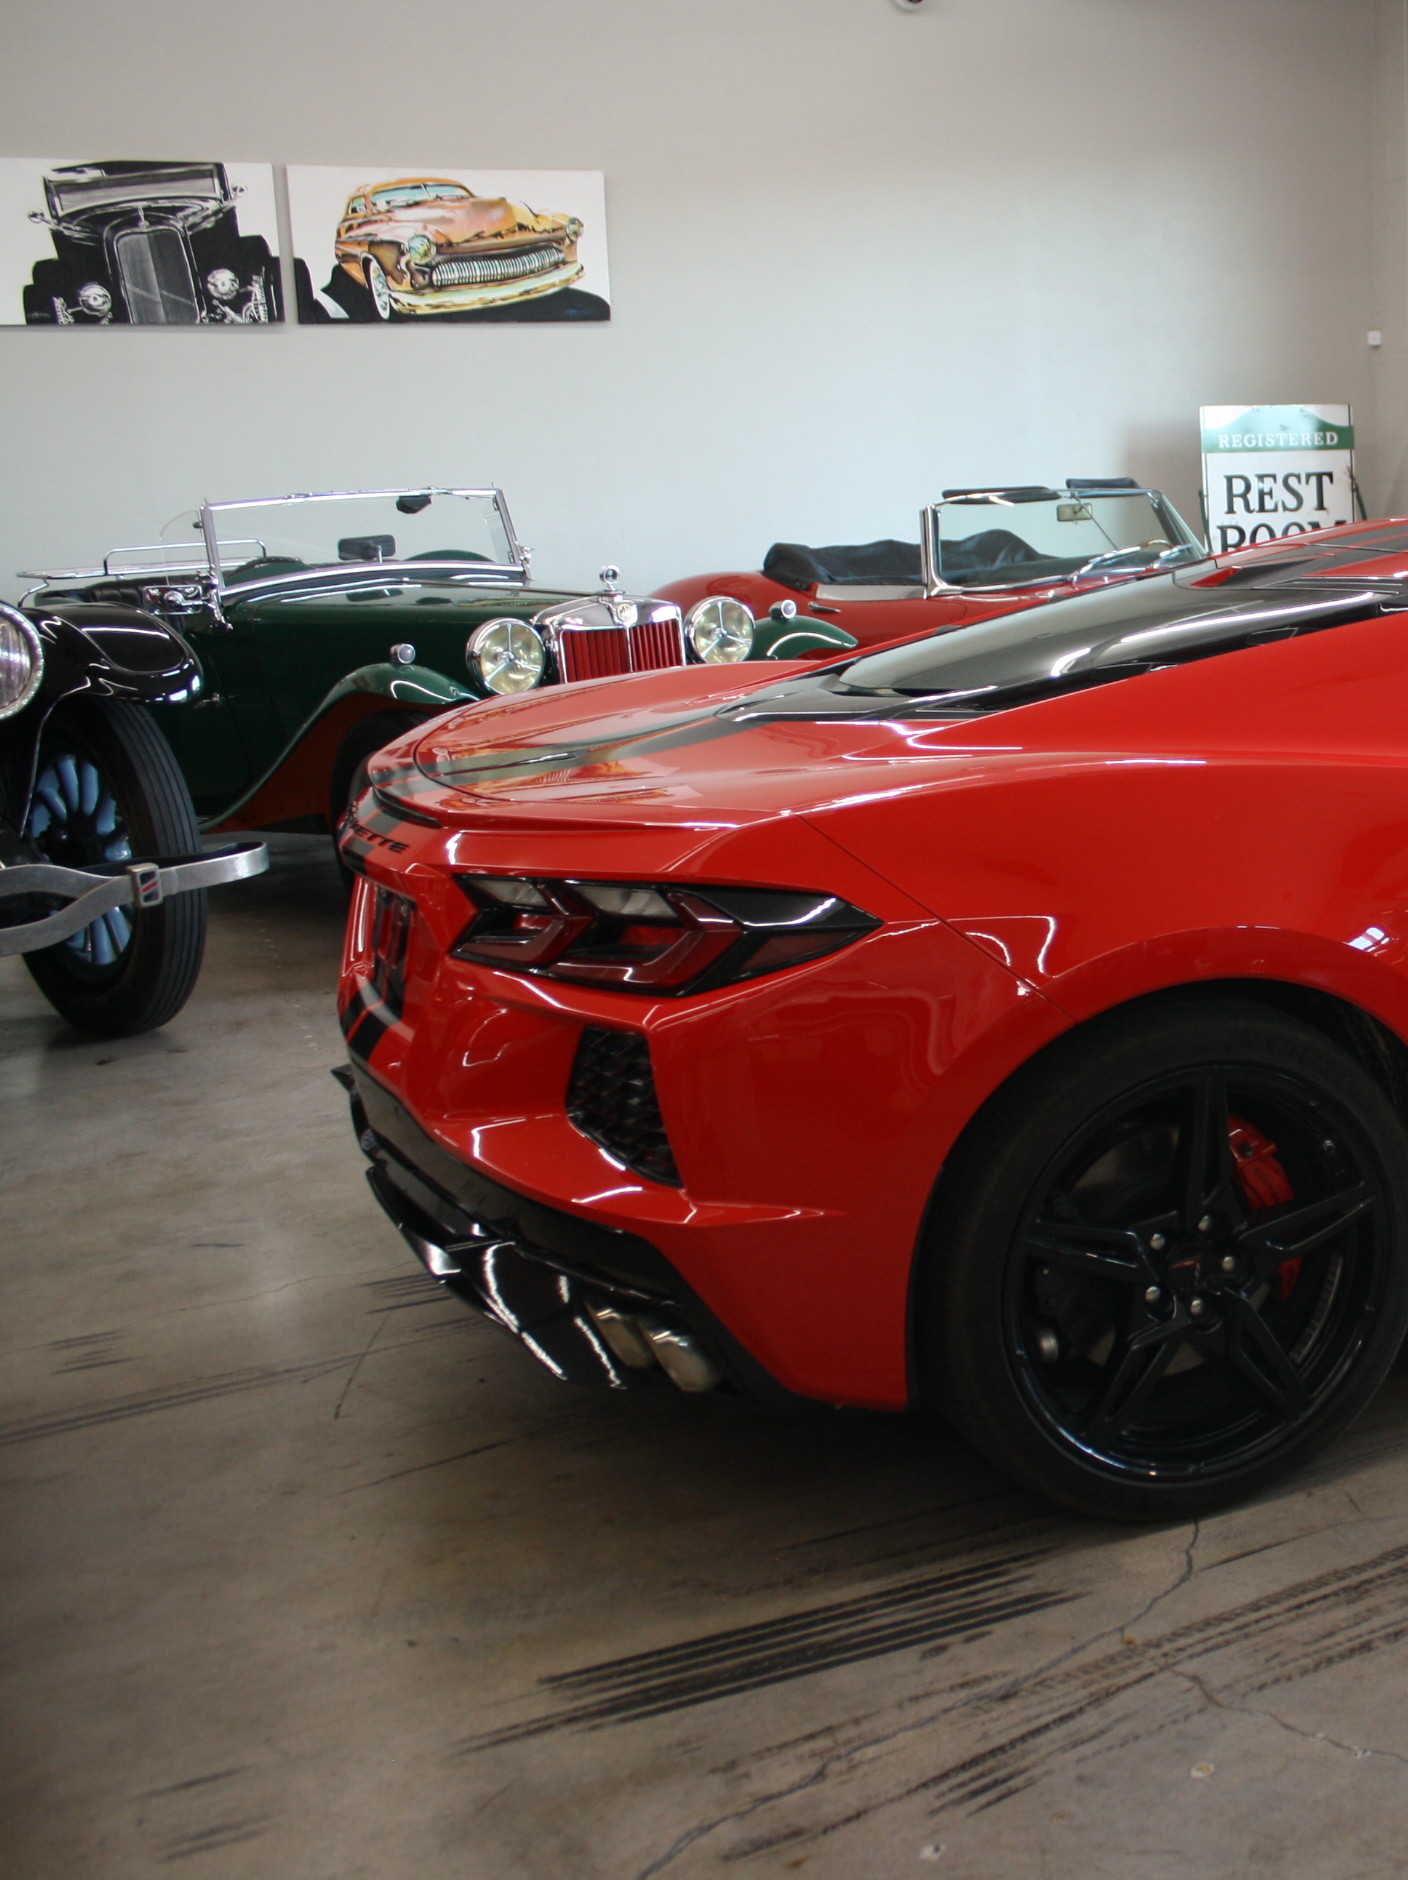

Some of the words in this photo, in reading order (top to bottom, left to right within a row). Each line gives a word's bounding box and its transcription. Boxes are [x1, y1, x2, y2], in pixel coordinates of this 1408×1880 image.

[1218, 432, 1338, 448] REGISTERED
[1223, 471, 1333, 514] REST
[1217, 520, 1346, 552] RO
